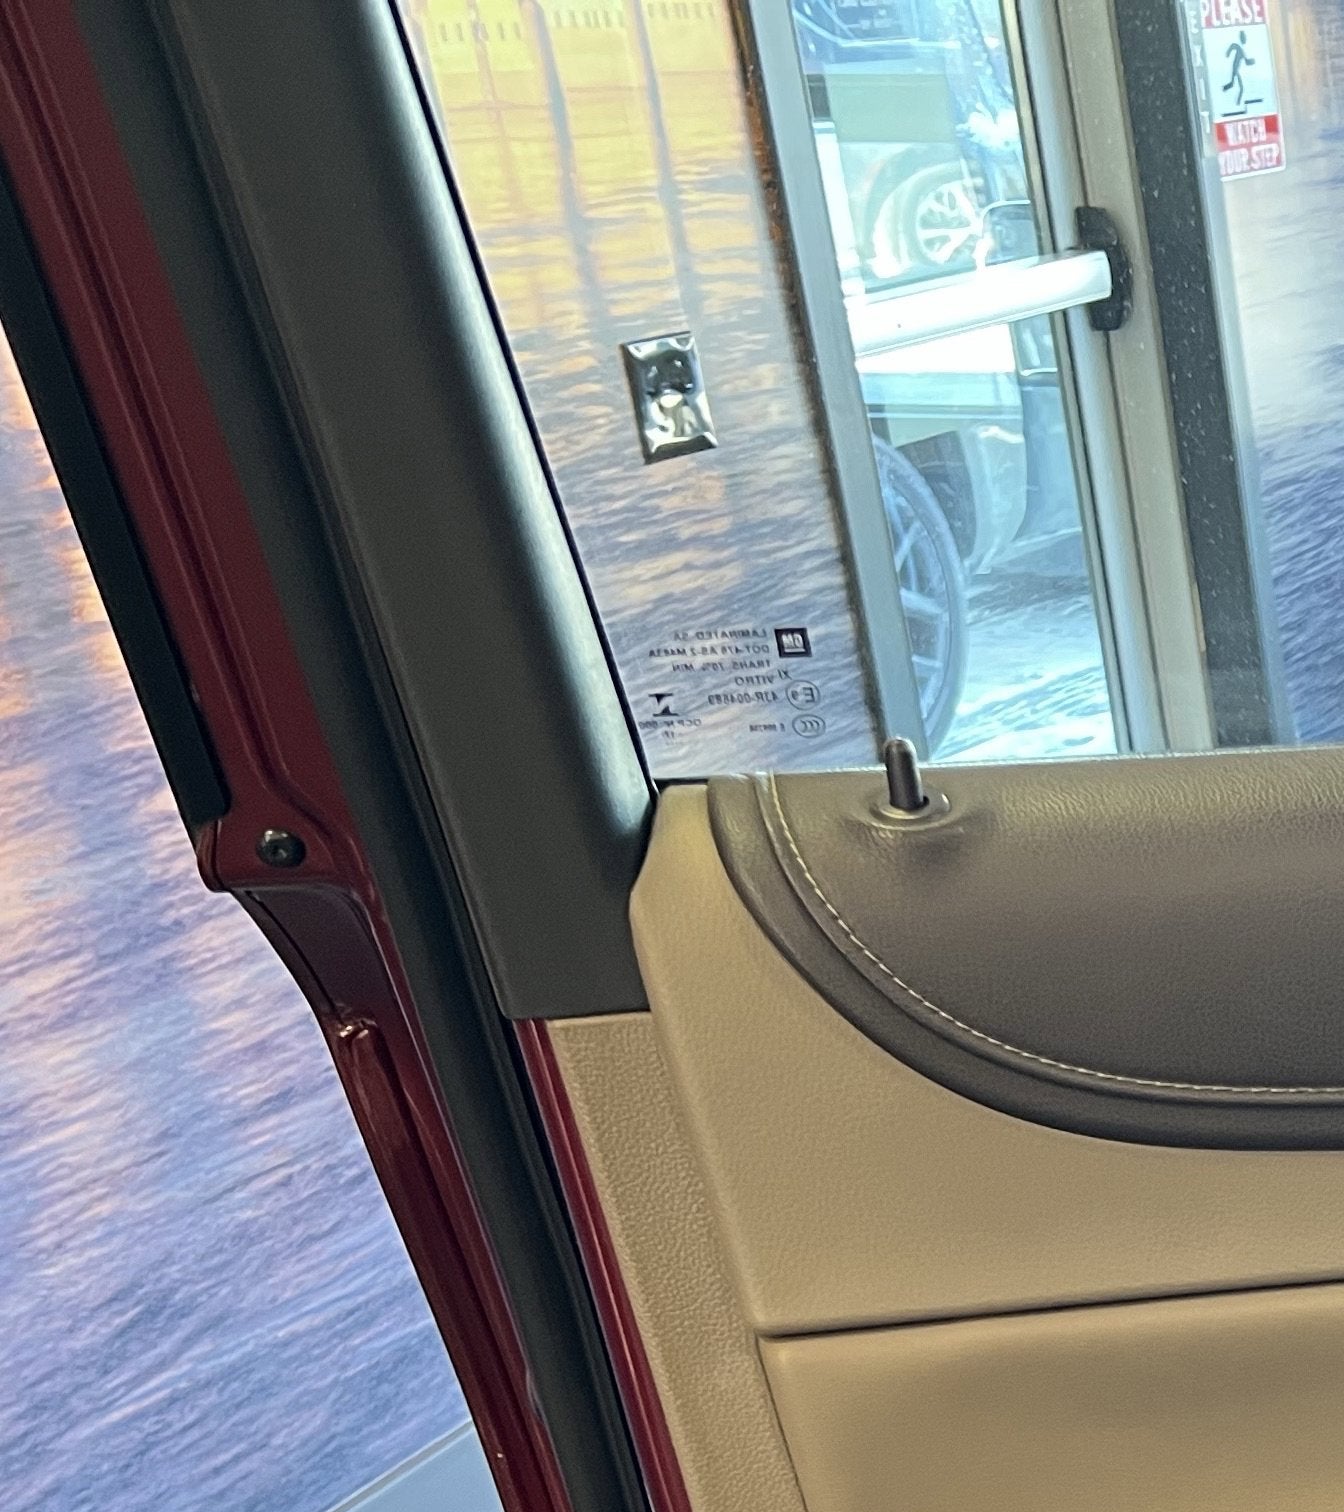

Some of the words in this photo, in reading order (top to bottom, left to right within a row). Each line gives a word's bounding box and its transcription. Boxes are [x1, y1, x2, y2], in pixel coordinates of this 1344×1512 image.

[1201, 0, 1264, 27] PLEASE
[1224, 120, 1267, 145] WATCH
[1251, 144, 1280, 169] STEP
